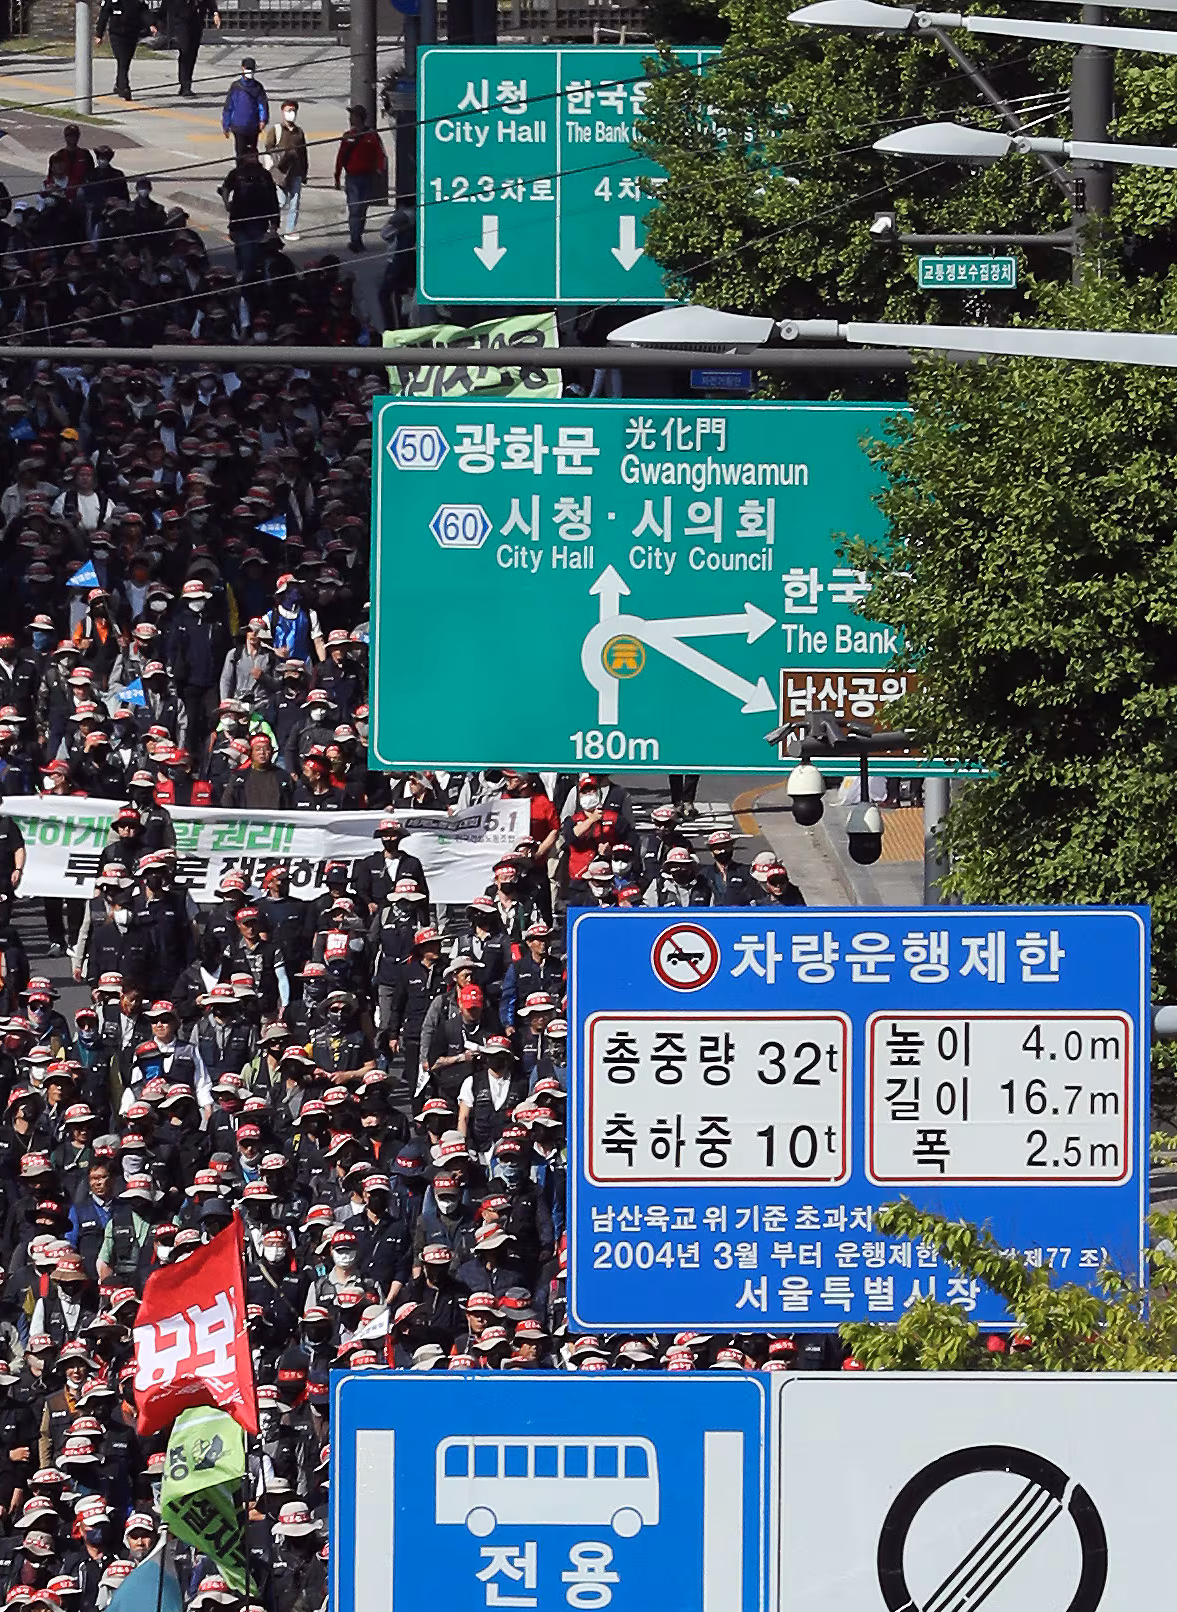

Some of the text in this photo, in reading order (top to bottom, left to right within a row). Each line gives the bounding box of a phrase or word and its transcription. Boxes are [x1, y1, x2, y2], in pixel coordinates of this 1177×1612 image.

[458, 78, 528, 116] 시청
[565, 78, 652, 116] 한국은
[434, 120, 547, 147] City Hall
[566, 121, 630, 143] The Bank
[400, 434, 436, 463] 50
[453, 424, 601, 477] 광화문
[625, 417, 728, 453] 光化門
[620, 454, 809, 493] Gwanghwamun
[443, 512, 479, 541] 60
[496, 545, 594, 574] City Hall
[629, 546, 774, 575] City Council
[781, 624, 899, 654] The Bank
[569, 730, 660, 761] 180m
[730, 929, 1066, 985] 차량운행제한
[601, 1030, 737, 1086] 총중량
[885, 1020, 1121, 1067] 높이 4.0m
[884, 1076, 1121, 1121] 길이 16.7m
[600, 1112, 734, 1170] 축하중
[912, 1127, 1121, 1174] 폭 2.5m
[590, 1205, 698, 1233] 남산육교
[703, 1205, 728, 1233] 위
[735, 1204, 789, 1233] 기준
[592, 1243, 700, 1270] 2004년
[714, 1243, 759, 1270] 3월
[771, 1243, 822, 1269] 부터
[735, 1276, 982, 1313] 서울특별시장
[474, 1540, 620, 1610] 전용
